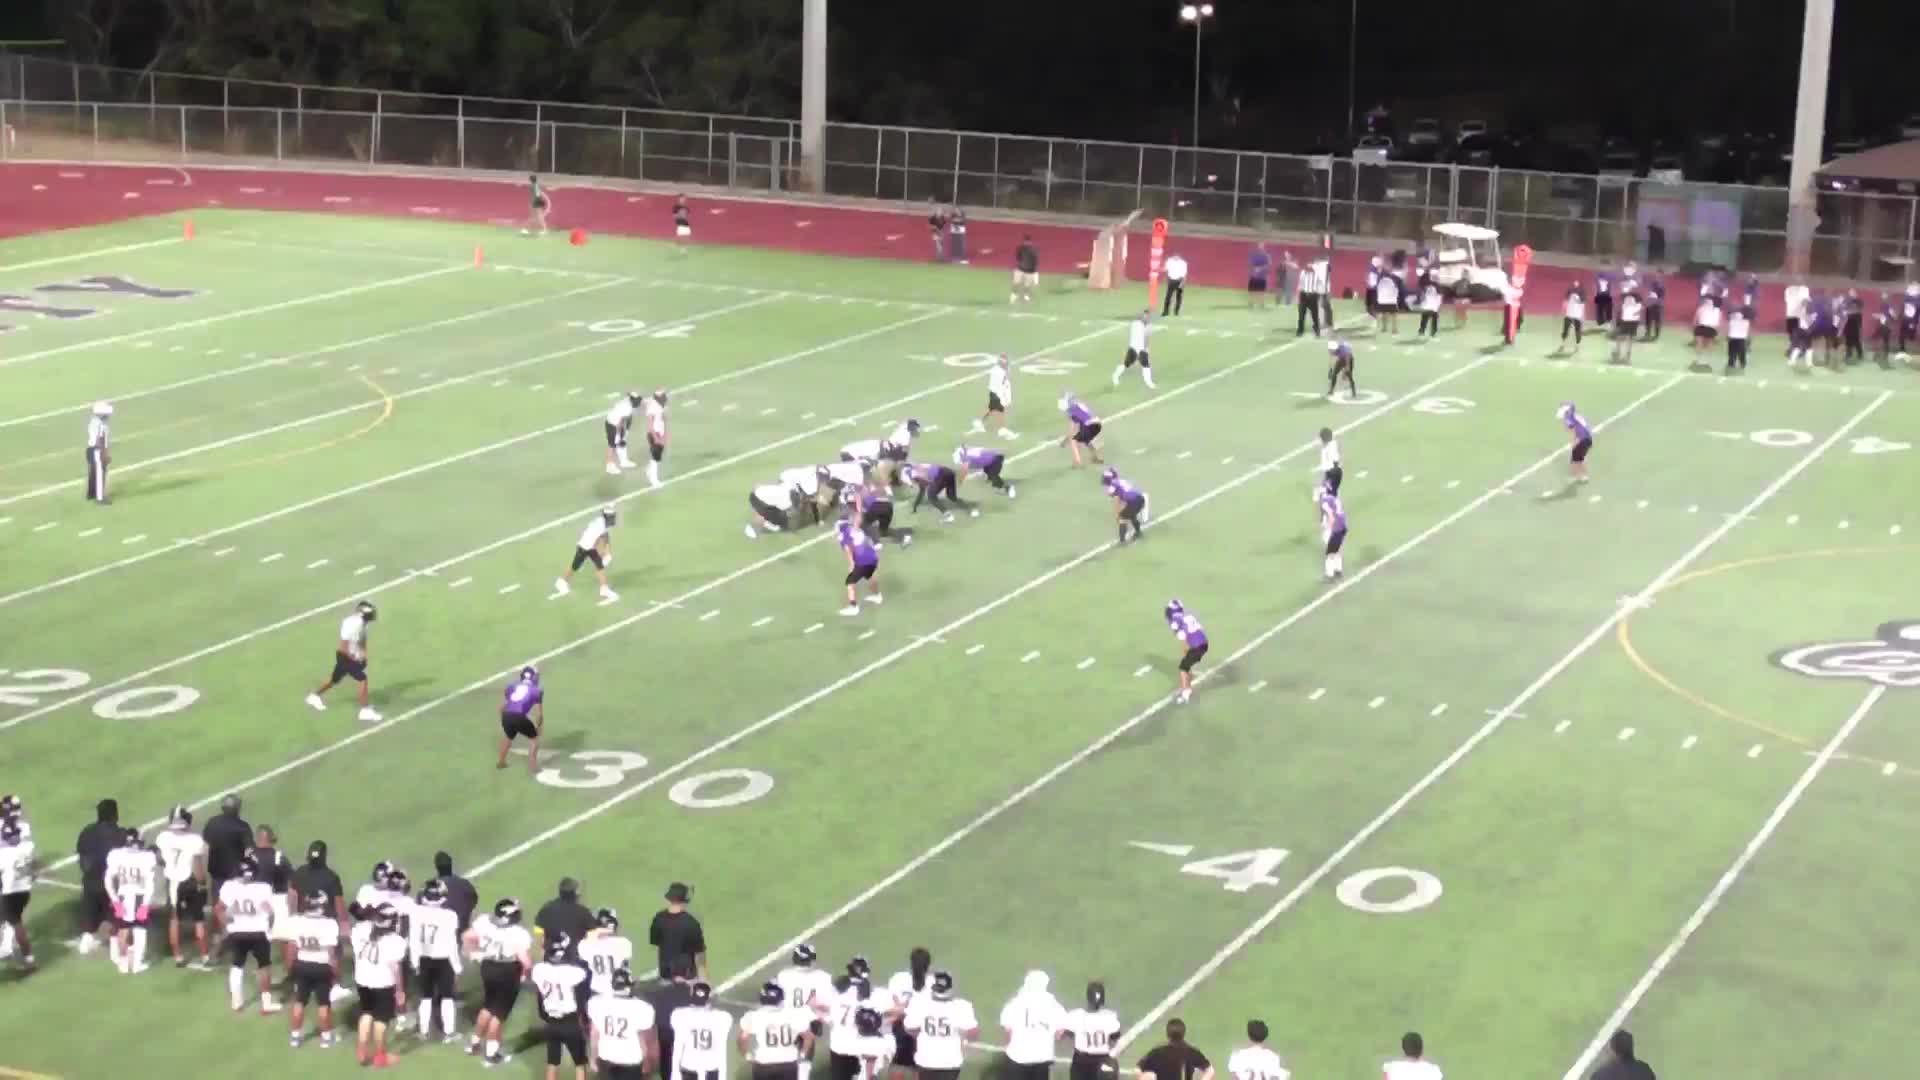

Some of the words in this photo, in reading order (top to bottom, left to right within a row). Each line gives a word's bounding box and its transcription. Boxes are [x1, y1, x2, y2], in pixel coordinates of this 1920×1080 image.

[535, 750, 774, 808] 30
[1178, 848, 1443, 913] 40
[420, 922, 438, 945] 17
[542, 978, 564, 1000] 21
[765, 1023, 793, 1047] 60
[924, 1015, 950, 1038] 65
[691, 1028, 713, 1051] 19
[1086, 1030, 1106, 1049] 10
